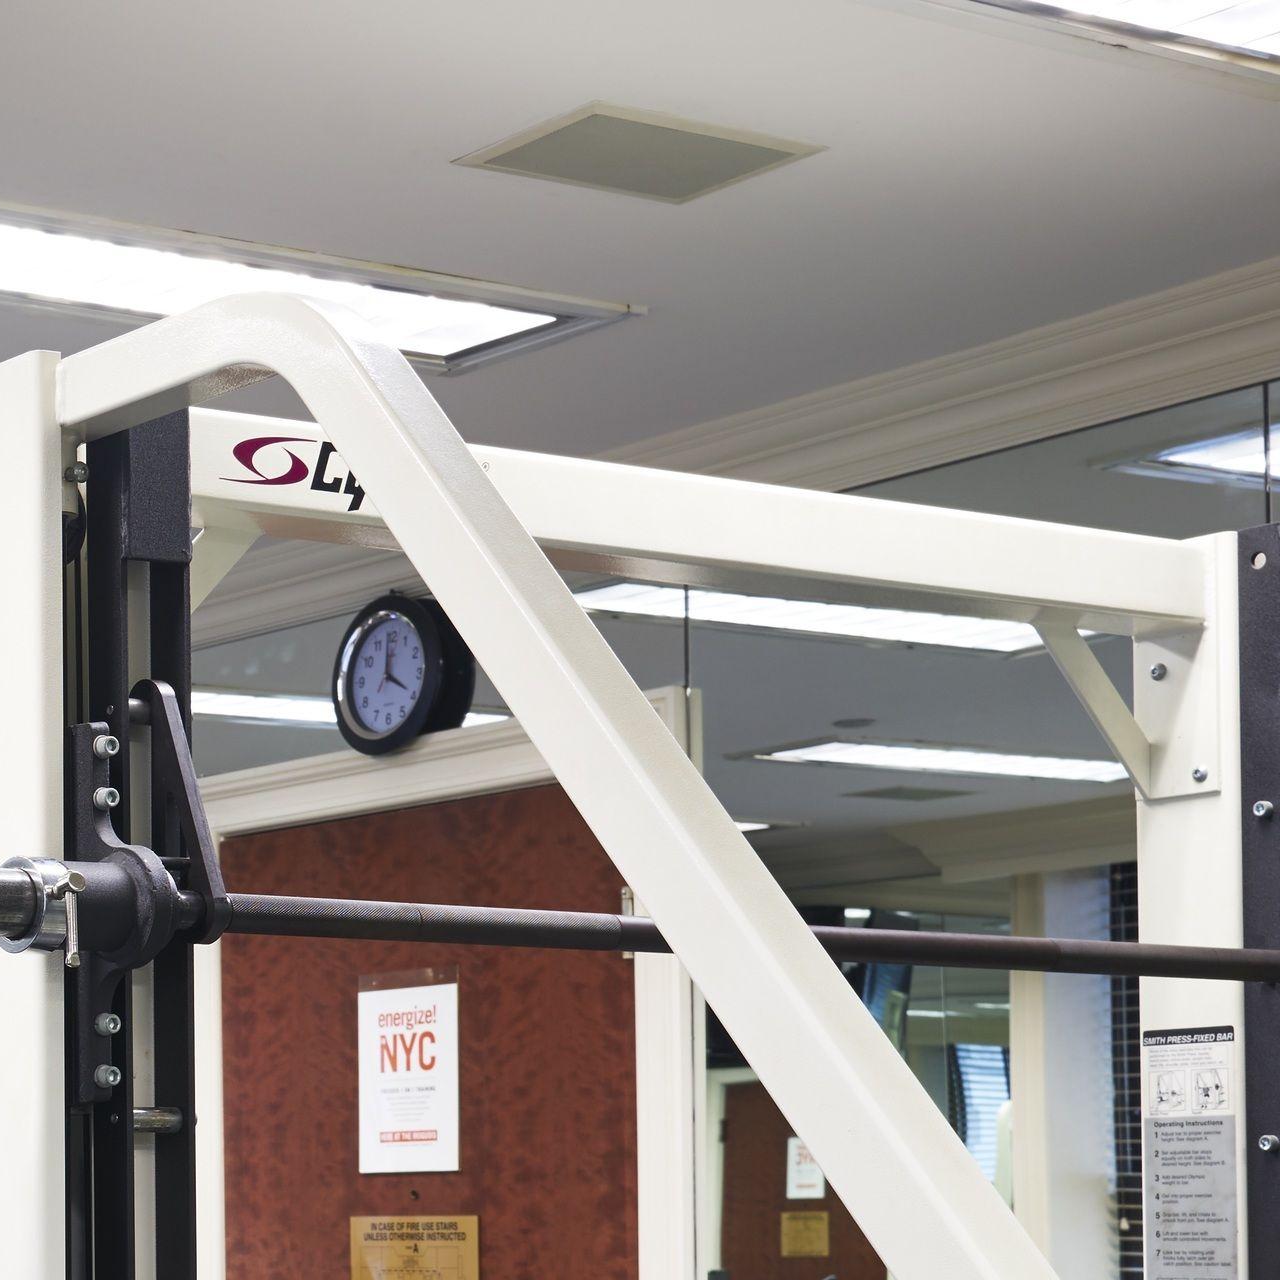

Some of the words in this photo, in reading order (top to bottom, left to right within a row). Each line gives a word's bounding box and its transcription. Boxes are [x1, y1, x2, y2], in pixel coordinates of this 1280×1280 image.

[374, 640, 382, 652] 11
[403, 636, 407, 646] 1
[412, 647, 419, 659] 2
[364, 656, 374, 668] 10
[416, 668, 422, 680] 3
[359, 677, 365, 688] 9
[362, 697, 368, 708] 8
[374, 710, 379, 721] 7
[399, 706, 406, 718] 5
[386, 713, 391, 725] 6
[378, 1004, 436, 1031] energize!
[1144, 1037, 1165, 1045] SMITH
[1167, 1034, 1215, 1044] PRESS-FIXED
[380, 1031, 436, 1073] NYC
[371, 1223, 378, 1231] IN
[379, 1223, 396, 1231] CASE
[397, 1222, 405, 1231] OF
[406, 1222, 420, 1231] FIRE
[421, 1222, 434, 1230] USE
[436, 1222, 458, 1230] STAIRS
[364, 1233, 388, 1241] UNLESS
[389, 1233, 425, 1241] OTHERWISE
[426, 1232, 466, 1241] INSTRUCTED
[413, 1243, 419, 1254] A
